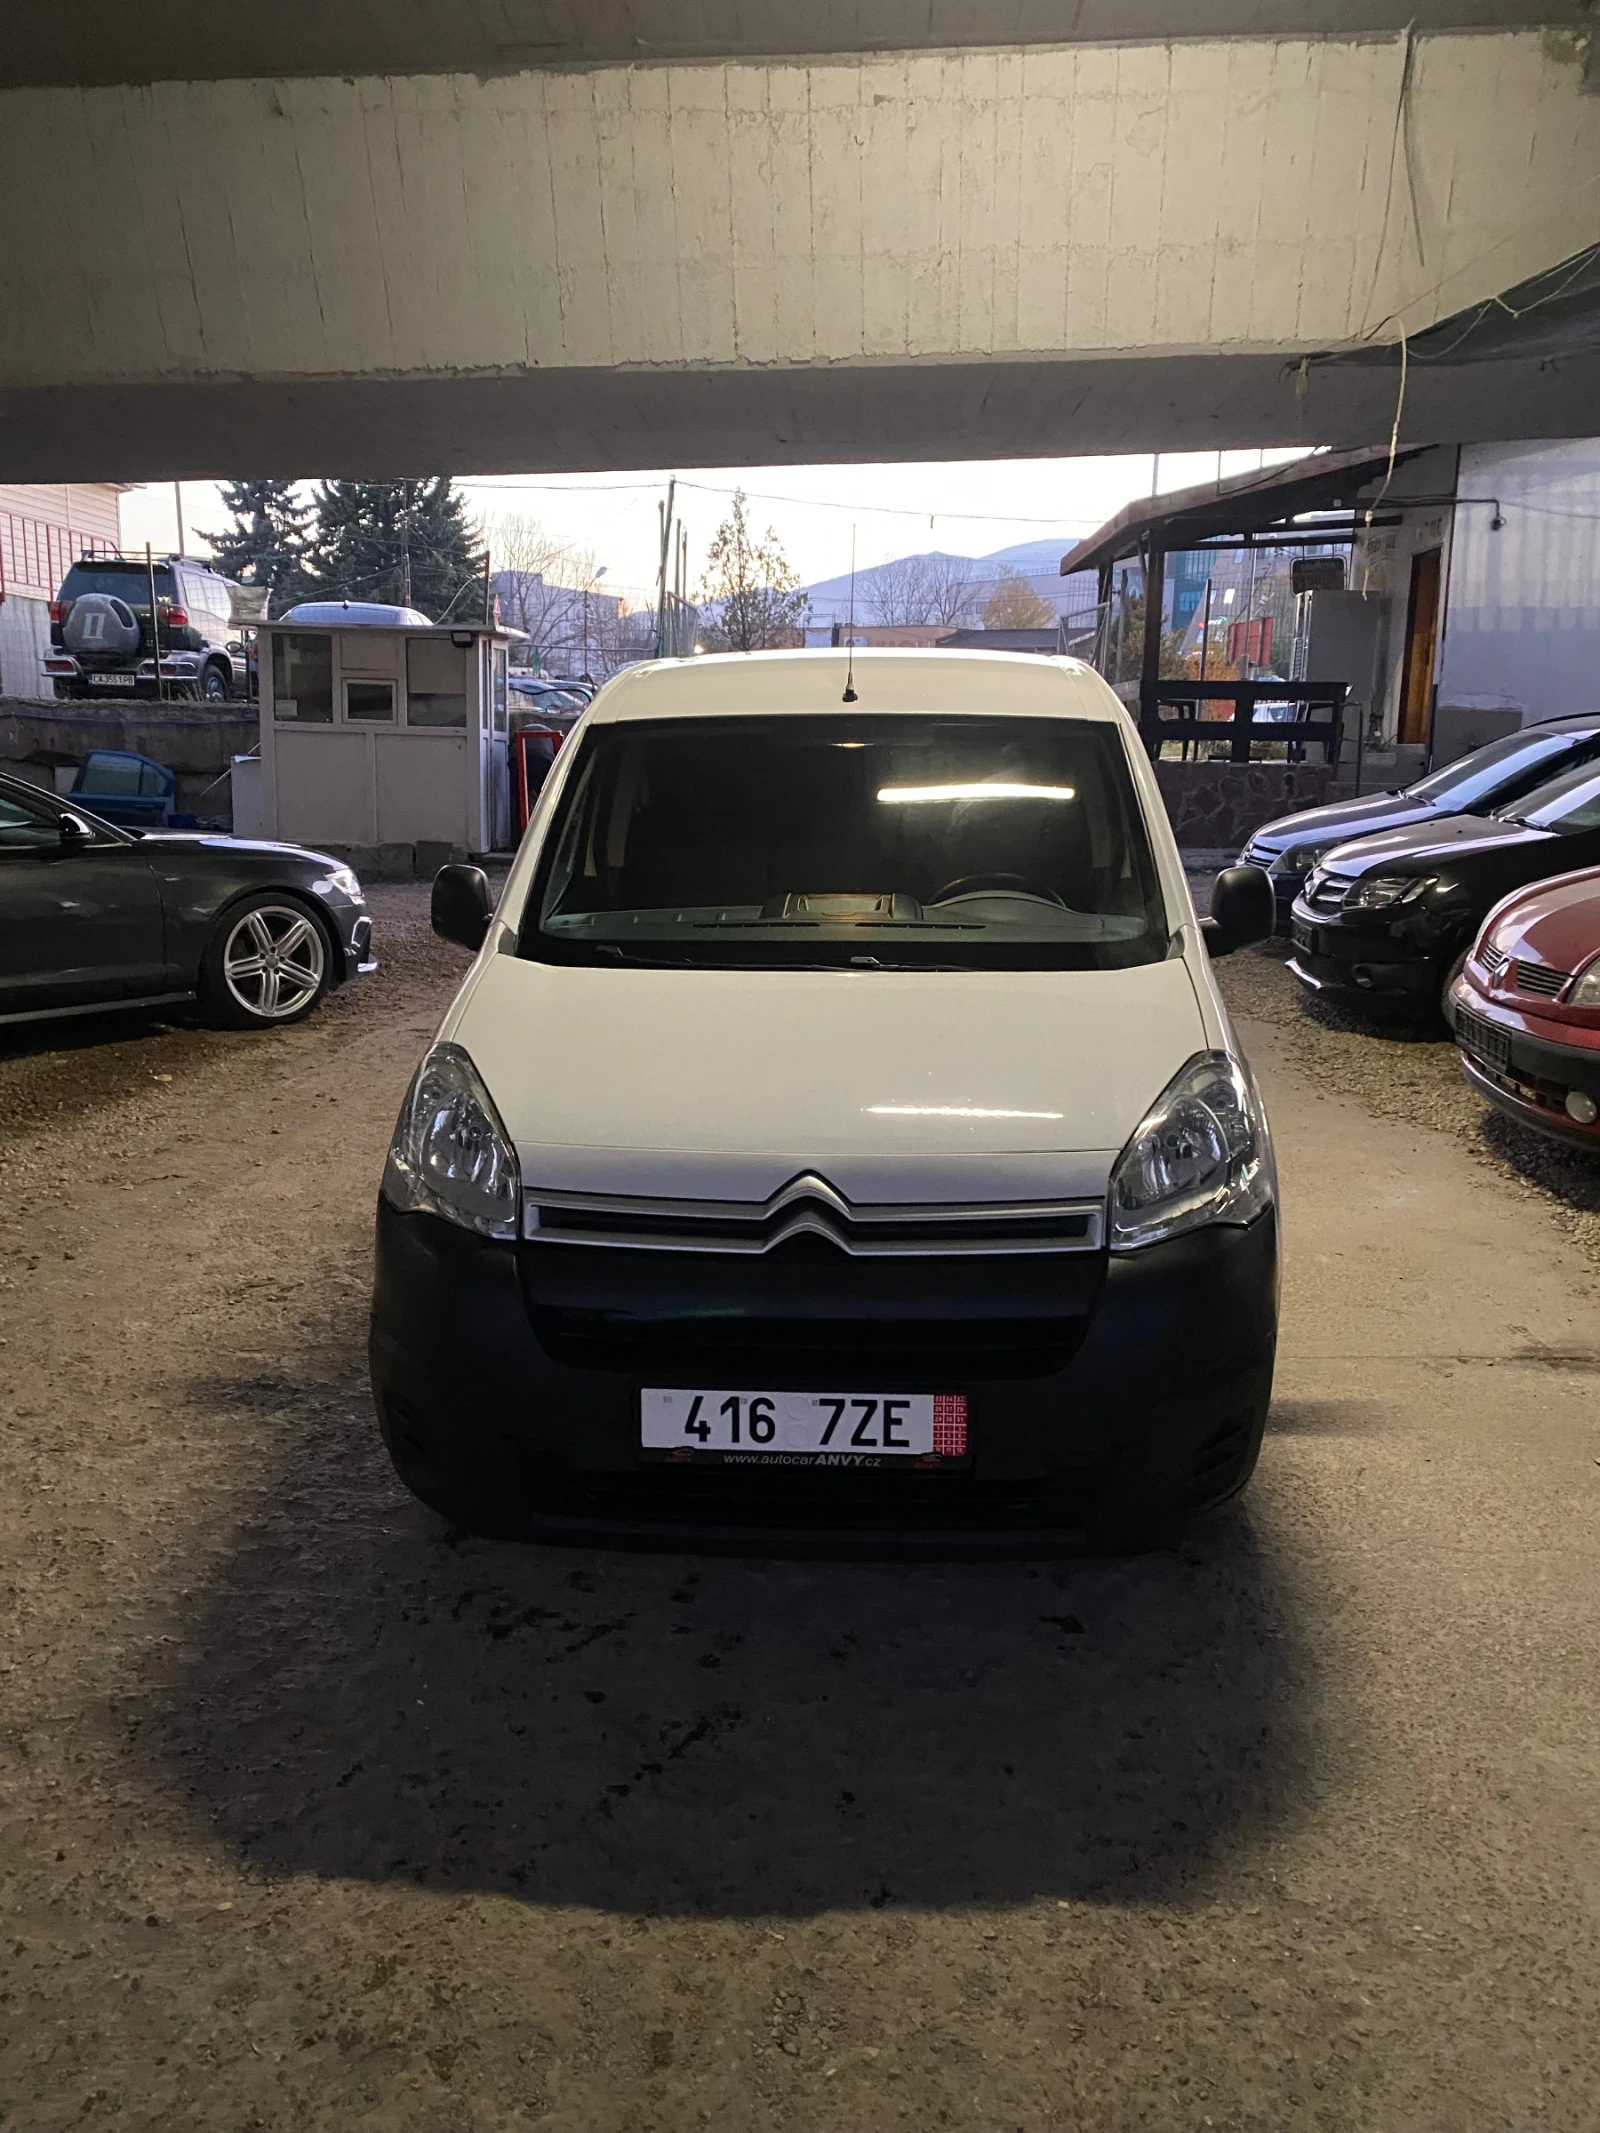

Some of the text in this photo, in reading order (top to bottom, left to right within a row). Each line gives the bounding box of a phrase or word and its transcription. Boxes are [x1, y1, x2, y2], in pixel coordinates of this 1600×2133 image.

[684, 1395, 911, 1447] 416 7ZE
[723, 1452, 882, 1468] www.autocarANVY.cz
